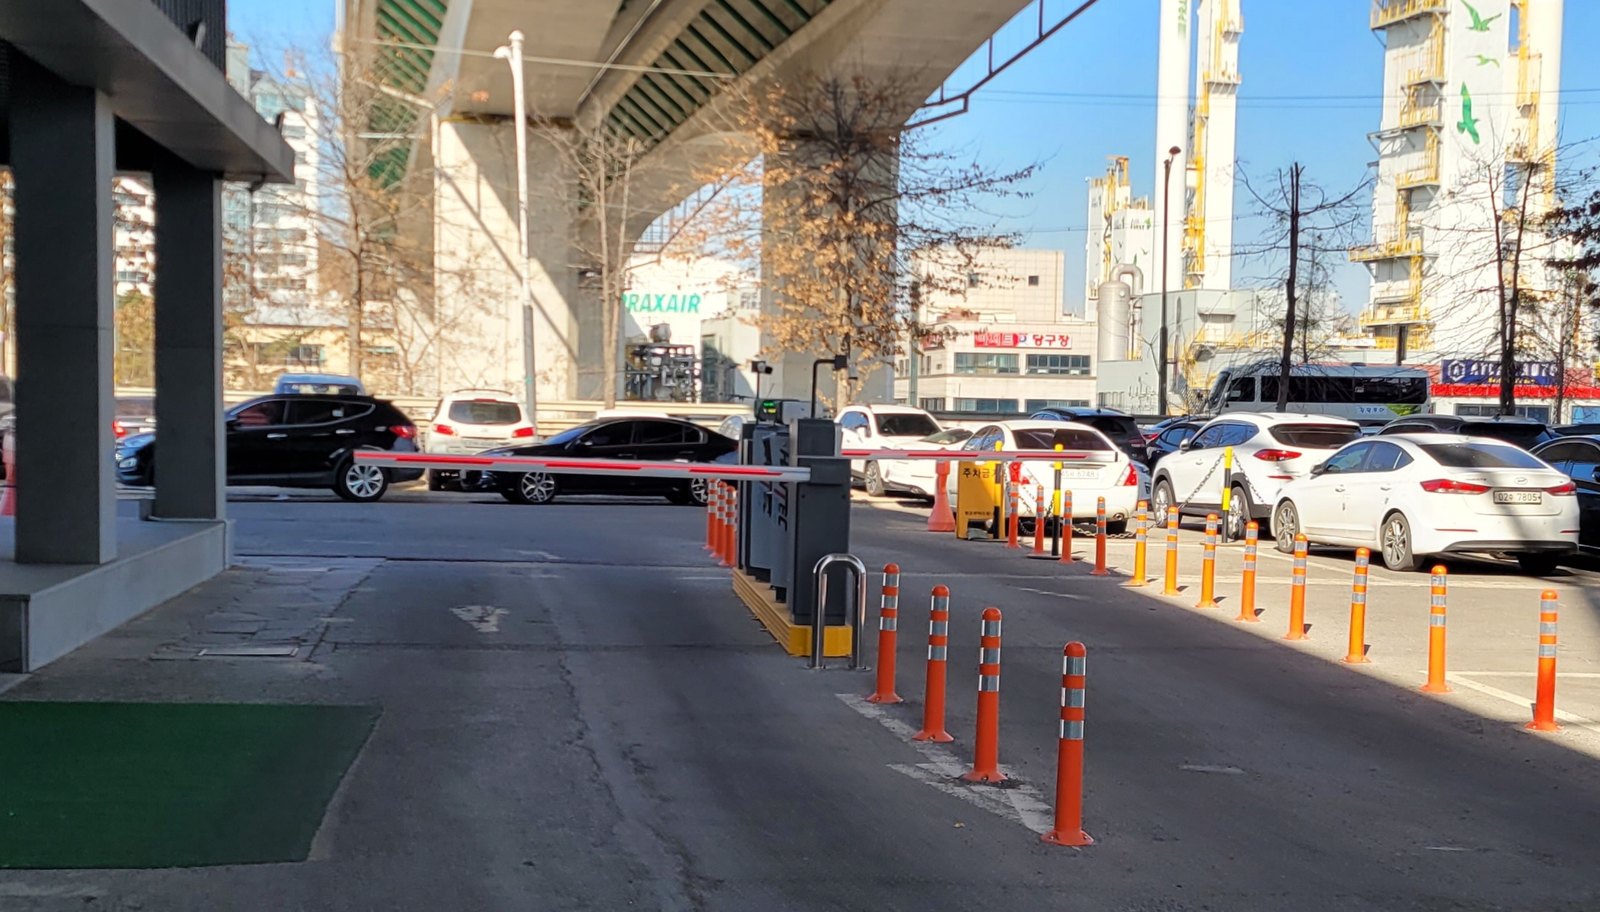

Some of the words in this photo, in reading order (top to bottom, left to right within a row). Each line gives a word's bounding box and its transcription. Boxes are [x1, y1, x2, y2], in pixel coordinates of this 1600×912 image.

[1032, 333, 1070, 347] 당구장
[962, 467, 995, 479] 주차금
[1516, 493, 1538, 502] 7805
